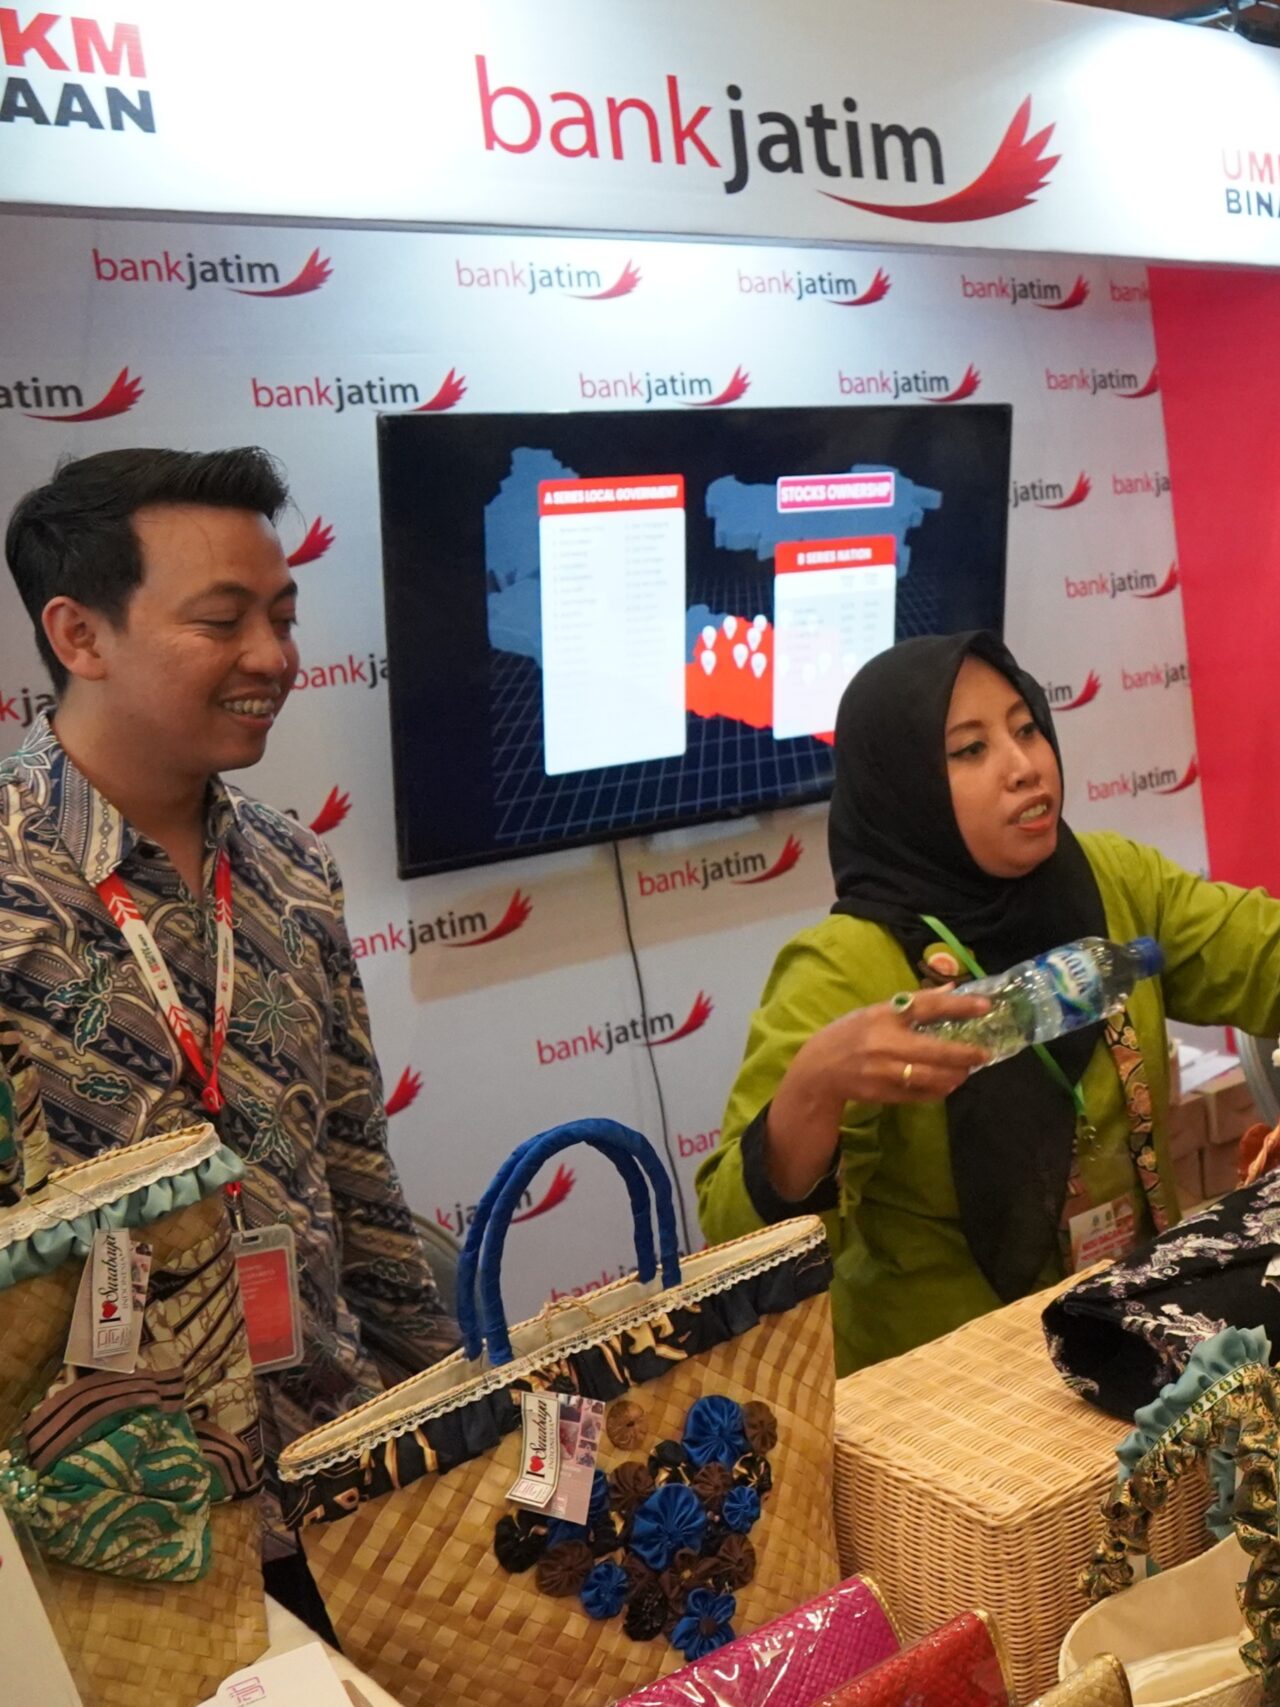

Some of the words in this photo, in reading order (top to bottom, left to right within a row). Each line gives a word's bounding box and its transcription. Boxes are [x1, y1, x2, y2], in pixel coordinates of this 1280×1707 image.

[474, 53, 946, 194] bankjatim
[92, 248, 281, 291] bankjatim
[456, 259, 602, 294] bankjatim
[737, 268, 858, 300] bankjatim
[961, 273, 1062, 303] bankjatim
[251, 376, 420, 413] bankjatim
[579, 371, 713, 402] bankjatim
[838, 369, 950, 399] bankjatim
[1045, 367, 1138, 394] bankjatim
[781, 484, 827, 503] STOCKS
[1065, 571, 1157, 600] bankjatim
[1087, 766, 1178, 802] bankjatim
[638, 848, 768, 898] bankjatim
[536, 1009, 675, 1066] bankjatim
[98, 1234, 123, 1303] Surabaya
[529, 1399, 552, 1460] Surabaya
